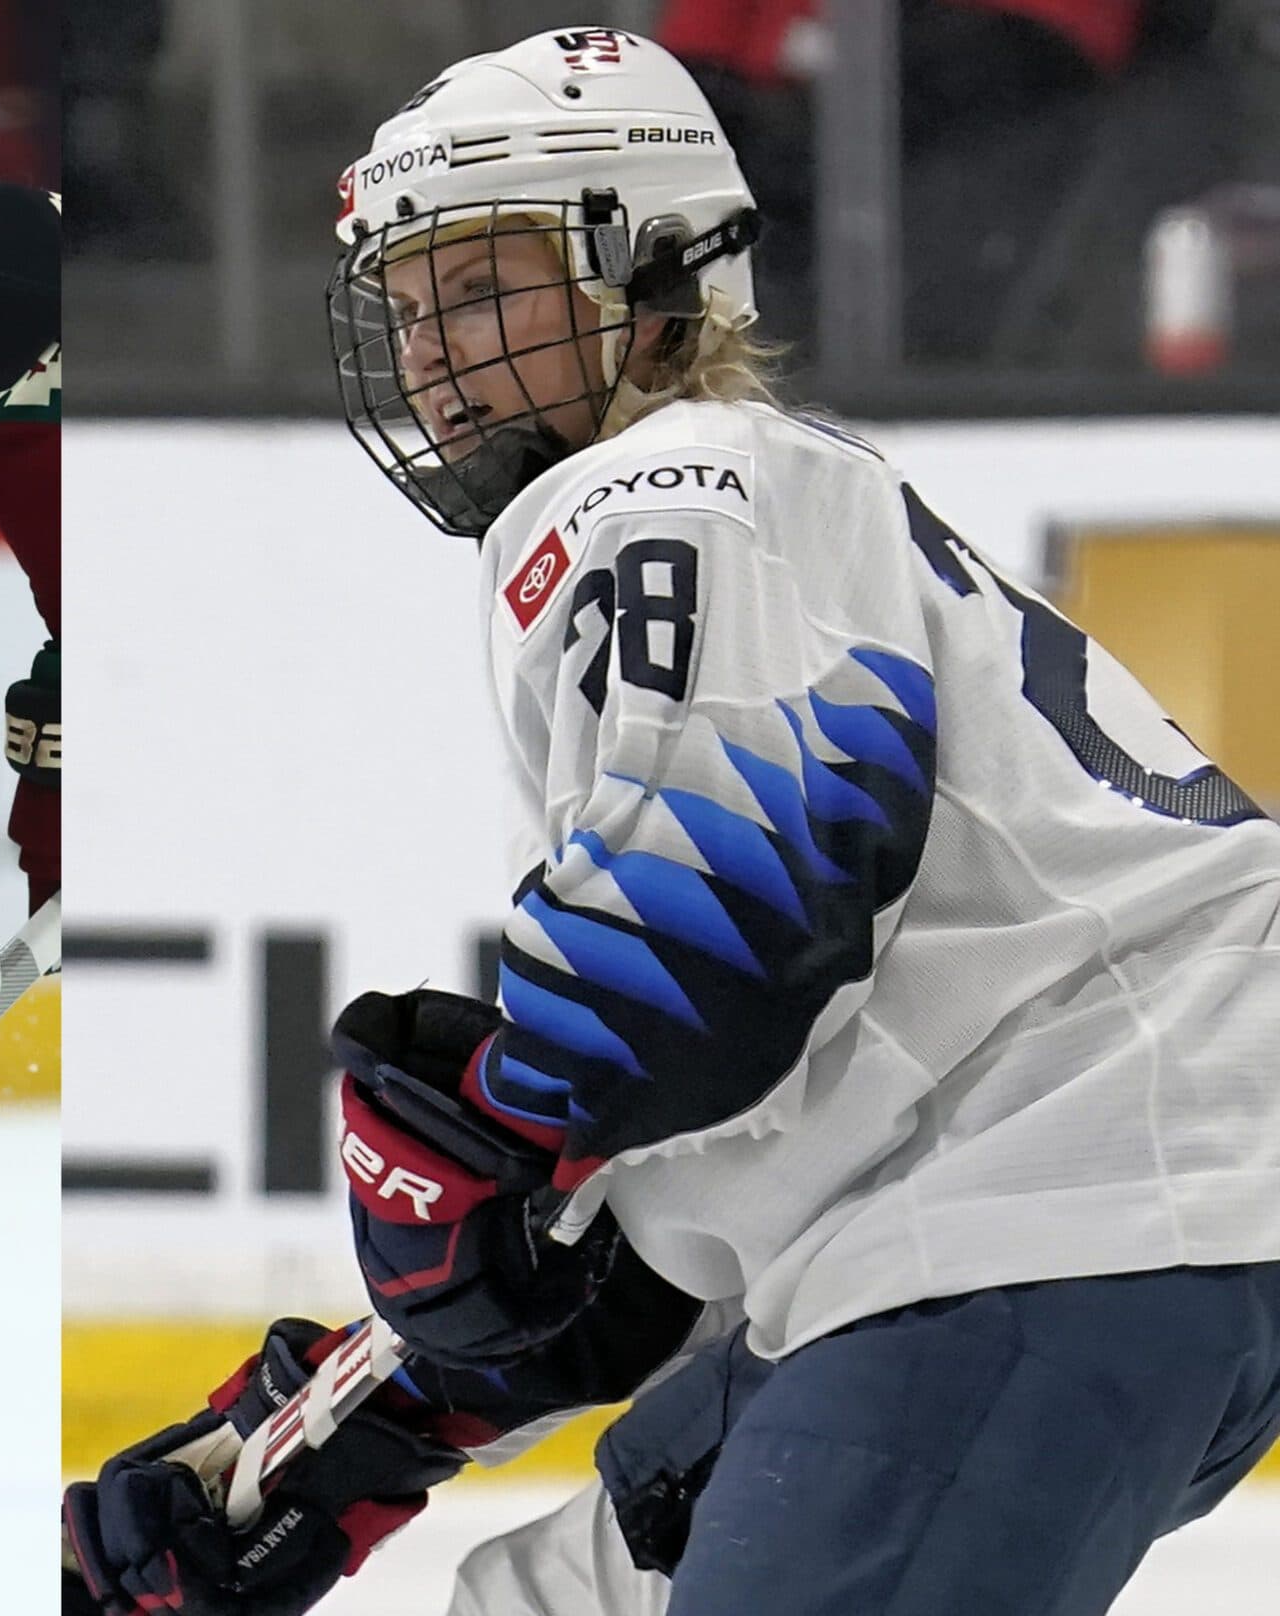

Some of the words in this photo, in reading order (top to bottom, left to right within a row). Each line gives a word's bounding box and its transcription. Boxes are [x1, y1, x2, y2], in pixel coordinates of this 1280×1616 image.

[627, 126, 717, 147] BAUER
[361, 142, 449, 190] TOYOTA
[682, 231, 723, 267] BAUE
[563, 464, 749, 536] TOYOTA
[563, 538, 699, 718] 28
[262, 1507, 304, 1549] TEAM
[237, 1543, 270, 1569] USA
